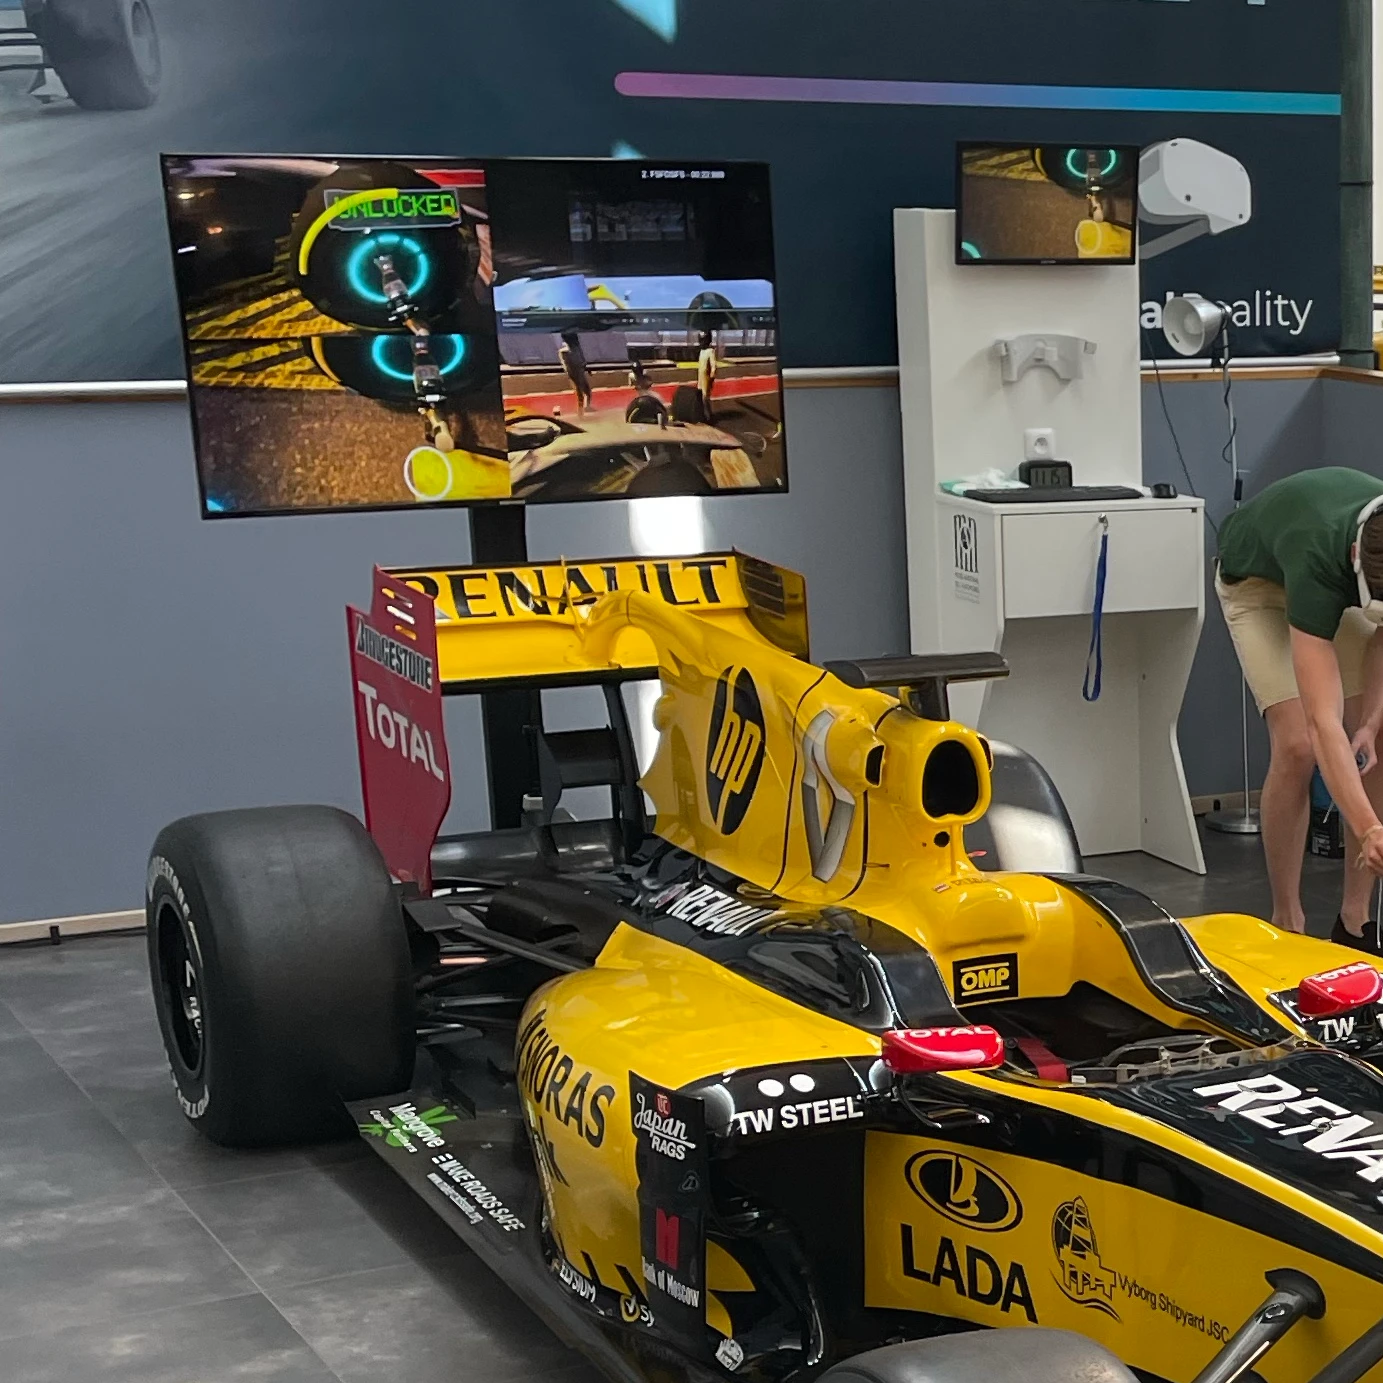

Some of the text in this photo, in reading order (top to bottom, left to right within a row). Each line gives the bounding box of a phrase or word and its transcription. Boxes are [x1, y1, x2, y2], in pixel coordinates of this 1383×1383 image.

[355, 619, 433, 694] BRIDGESTONE
[357, 680, 444, 782] TOTAL
[960, 966, 1010, 991] OMP
[889, 1027, 995, 1039] TOTAL
[1317, 1016, 1355, 1043] TW
[633, 1092, 688, 1141] Japan
[735, 1096, 864, 1136] TW STEEL
[651, 1135, 687, 1161] RAGS
[900, 1222, 1039, 1325] LADA
[1119, 1274, 1231, 1345] Vyborg Shipyard JSC
